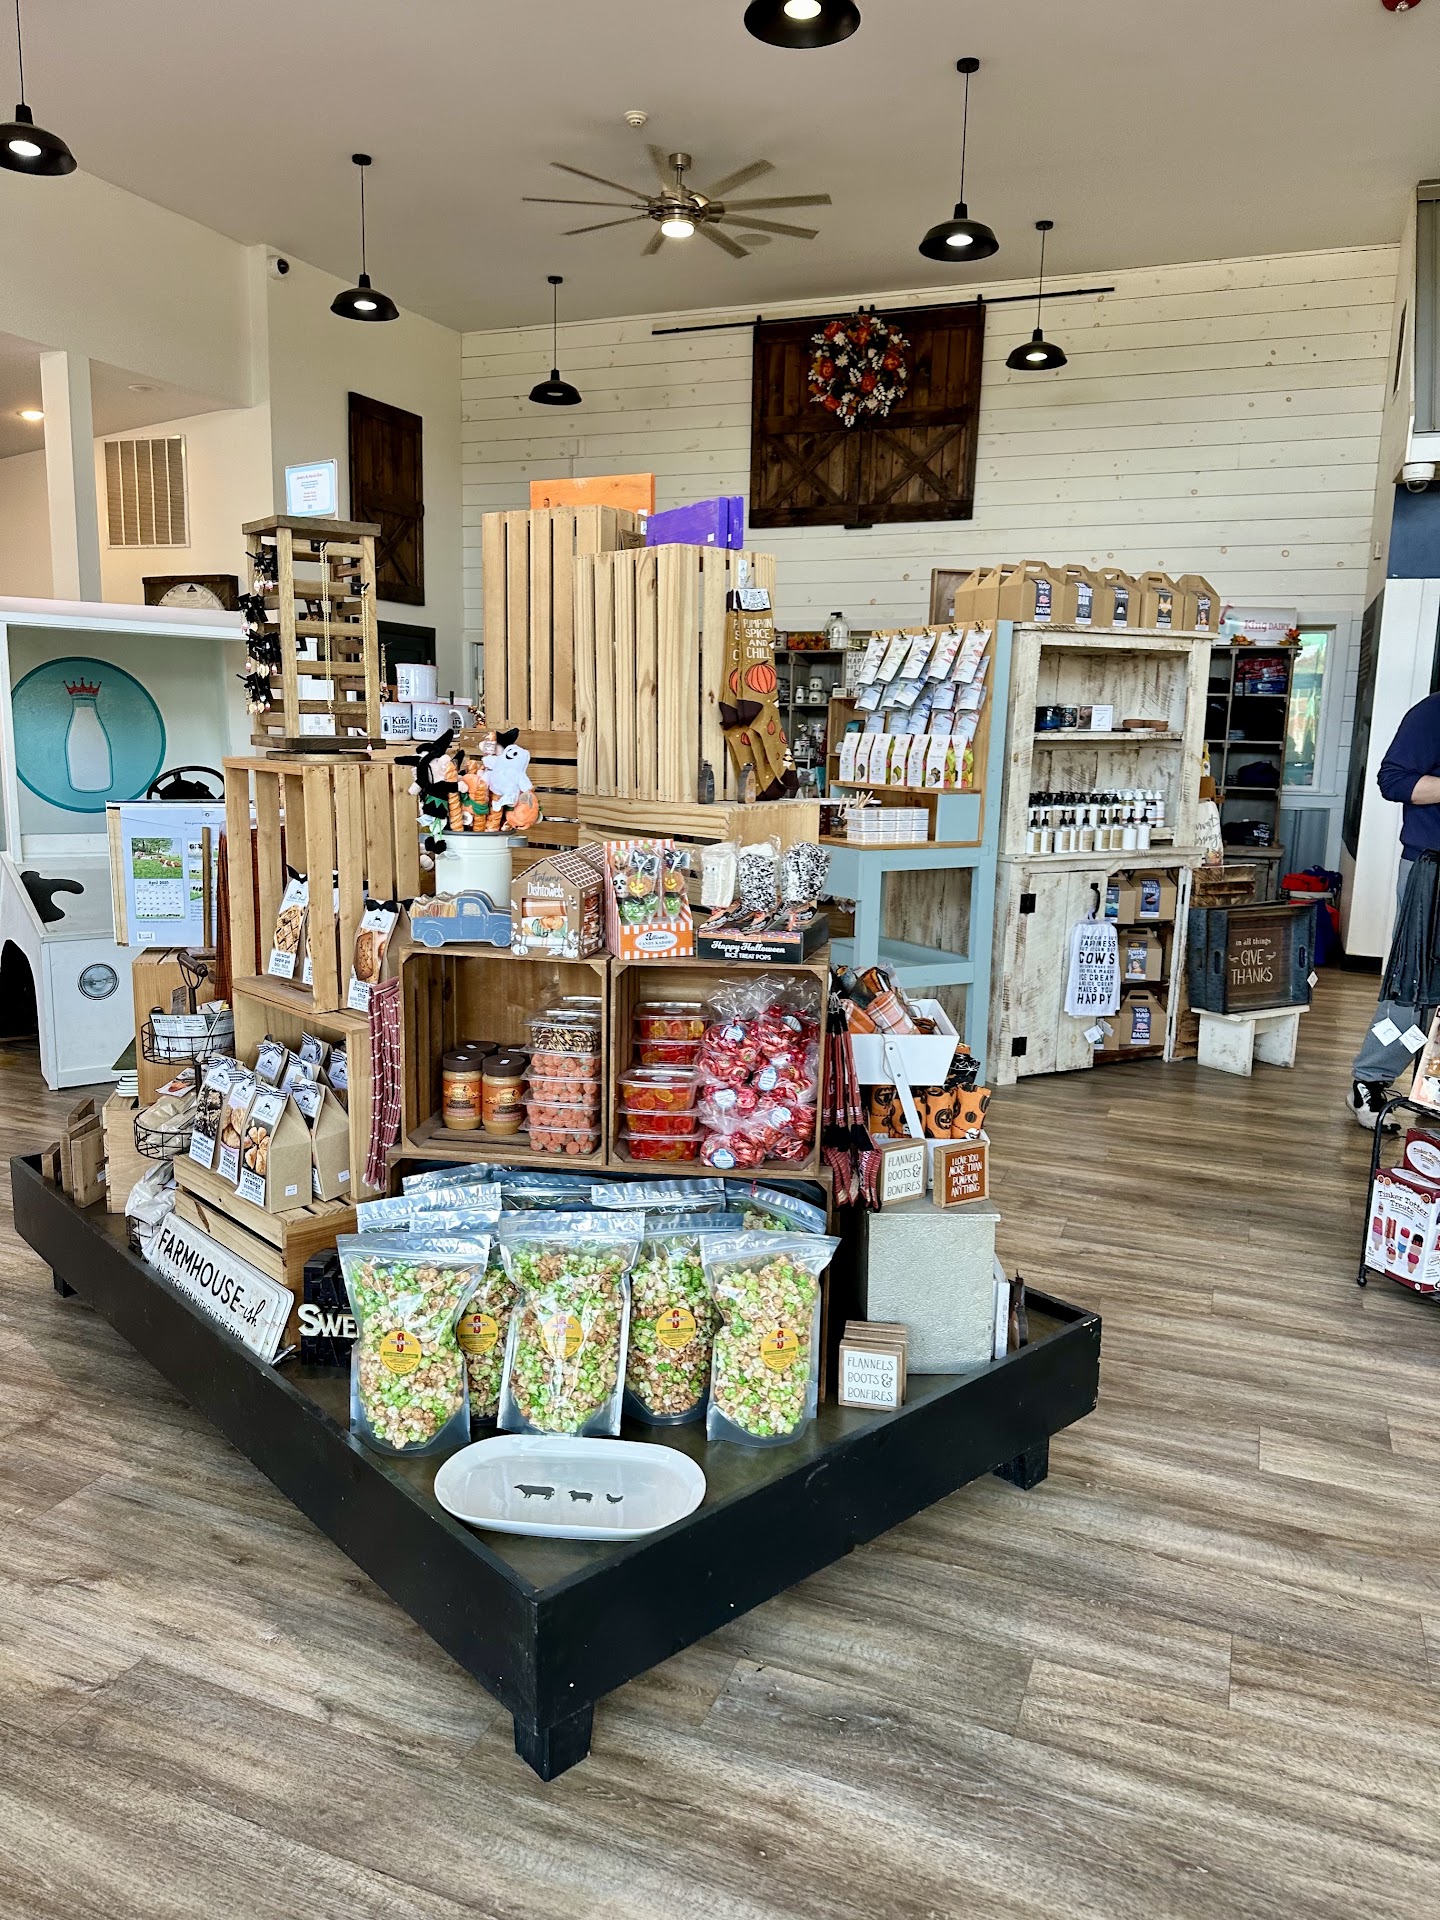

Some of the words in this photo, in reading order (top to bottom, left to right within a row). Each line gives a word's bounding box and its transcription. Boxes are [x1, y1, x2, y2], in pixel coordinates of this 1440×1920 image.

[1036, 606, 1051, 614] BACON
[743, 617, 773, 629] PUMPKIN
[1244, 620, 1270, 632] King
[745, 628, 771, 639] SPICE
[748, 639, 768, 647] AND
[746, 647, 773, 659] CHILL
[391, 715, 410, 725] King
[527, 881, 564, 898] Dishtowels
[711, 940, 741, 954] Happy
[740, 942, 786, 954] Halloween
[1242, 937, 1252, 946] all
[1252, 937, 1272, 946] things
[738, 952, 756, 960] TREAT
[755, 953, 772, 961] POPS
[1079, 951, 1115, 965] COWS
[1240, 948, 1265, 967] GIVE
[1078, 973, 1087, 981] ICE
[1088, 974, 1114, 982] CREAM
[1230, 966, 1273, 985] THANKS
[1076, 993, 1113, 1005] HAPPY
[1132, 1031, 1150, 1039] BACON
[888, 1151, 922, 1168] FLANNELS
[951, 1157, 955, 1166] I
[954, 1155, 968, 1166] LOVE
[967, 1153, 979, 1163] YOU
[887, 1167, 912, 1182] BOOTS
[912, 1163, 922, 1178] &
[948, 1164, 966, 1178] MORE
[967, 1161, 983, 1172] THAN
[242, 1170, 264, 1186] cranberry
[244, 1177, 261, 1190] orange
[952, 1172, 979, 1187] PUMPKIN
[886, 1180, 921, 1197] BONFIRES
[950, 1182, 981, 1198] ANYTHING
[1378, 1190, 1403, 1202] Tinker
[1389, 1198, 1415, 1216] Treats
[157, 1227, 267, 1329] FARMHOUSE-ish
[156, 1264, 166, 1278] ALL
[174, 1279, 194, 1301] CHARM
[218, 1315, 230, 1329] THE
[228, 1324, 246, 1342] FARM
[297, 1303, 359, 1339] SWE
[847, 1356, 894, 1372] FLANNELS
[847, 1371, 880, 1385] BOOTS
[880, 1373, 894, 1389] &
[847, 1386, 893, 1402] BONFIRES
